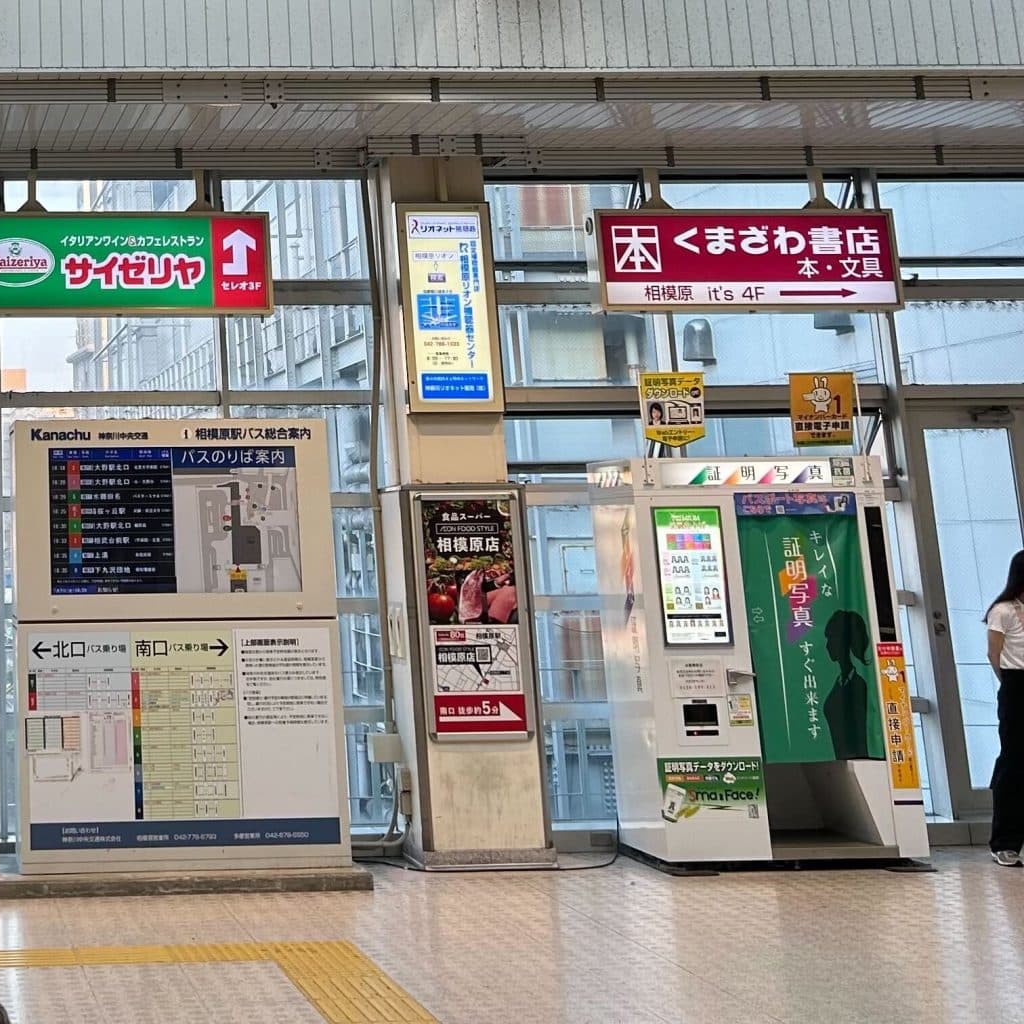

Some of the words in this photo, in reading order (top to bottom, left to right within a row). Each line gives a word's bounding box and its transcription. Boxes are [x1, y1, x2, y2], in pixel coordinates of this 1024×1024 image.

[674, 225, 881, 255] くまざわ書店
[62, 253, 205, 288] サイゼリヤ
[797, 257, 884, 278] 本・文具
[220, 280, 262, 291] セレオ3F
[644, 285, 694, 301] 相模原
[708, 285, 734, 302] it's
[742, 285, 765, 301] 4F
[31, 427, 91, 441] Kanachu
[195, 427, 312, 441] 相模原駅バス総合案内
[181, 450, 286, 464] バスのりば案内
[705, 464, 824, 481] 証明写真
[441, 511, 492, 522] 食品スーパー
[436, 535, 500, 553] 相模原店
[808, 529, 834, 598] キレイな
[782, 536, 815, 628] 証明写真
[798, 640, 822, 740] すぐ出来ます
